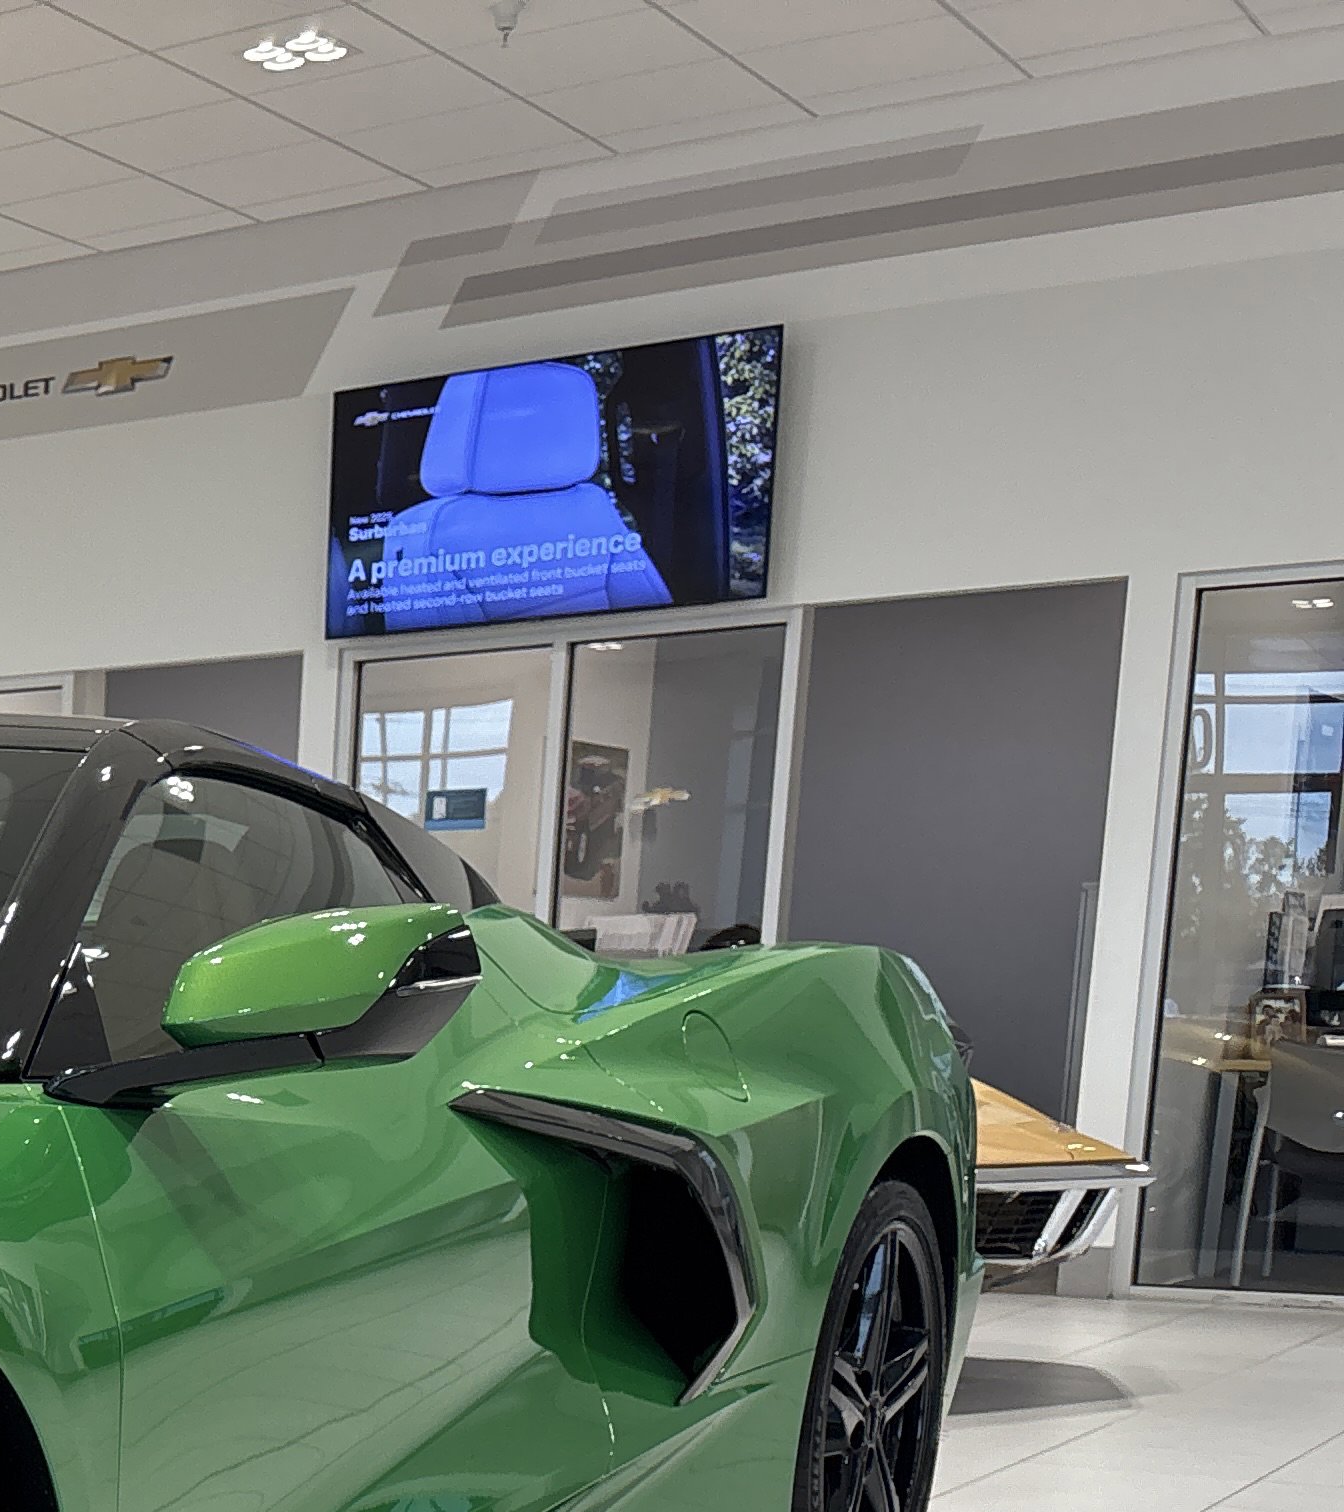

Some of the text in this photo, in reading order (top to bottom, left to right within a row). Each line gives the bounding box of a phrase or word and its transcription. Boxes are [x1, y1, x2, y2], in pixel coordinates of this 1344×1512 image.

[348, 533, 642, 584] A premium experience
[400, 580, 442, 595] heated
[443, 577, 467, 590] and
[468, 571, 529, 587] ventilated
[531, 567, 563, 581] front
[564, 563, 609, 579] bucket
[610, 559, 646, 574] seats
[346, 583, 564, 616] and heated second-row bucket seats
